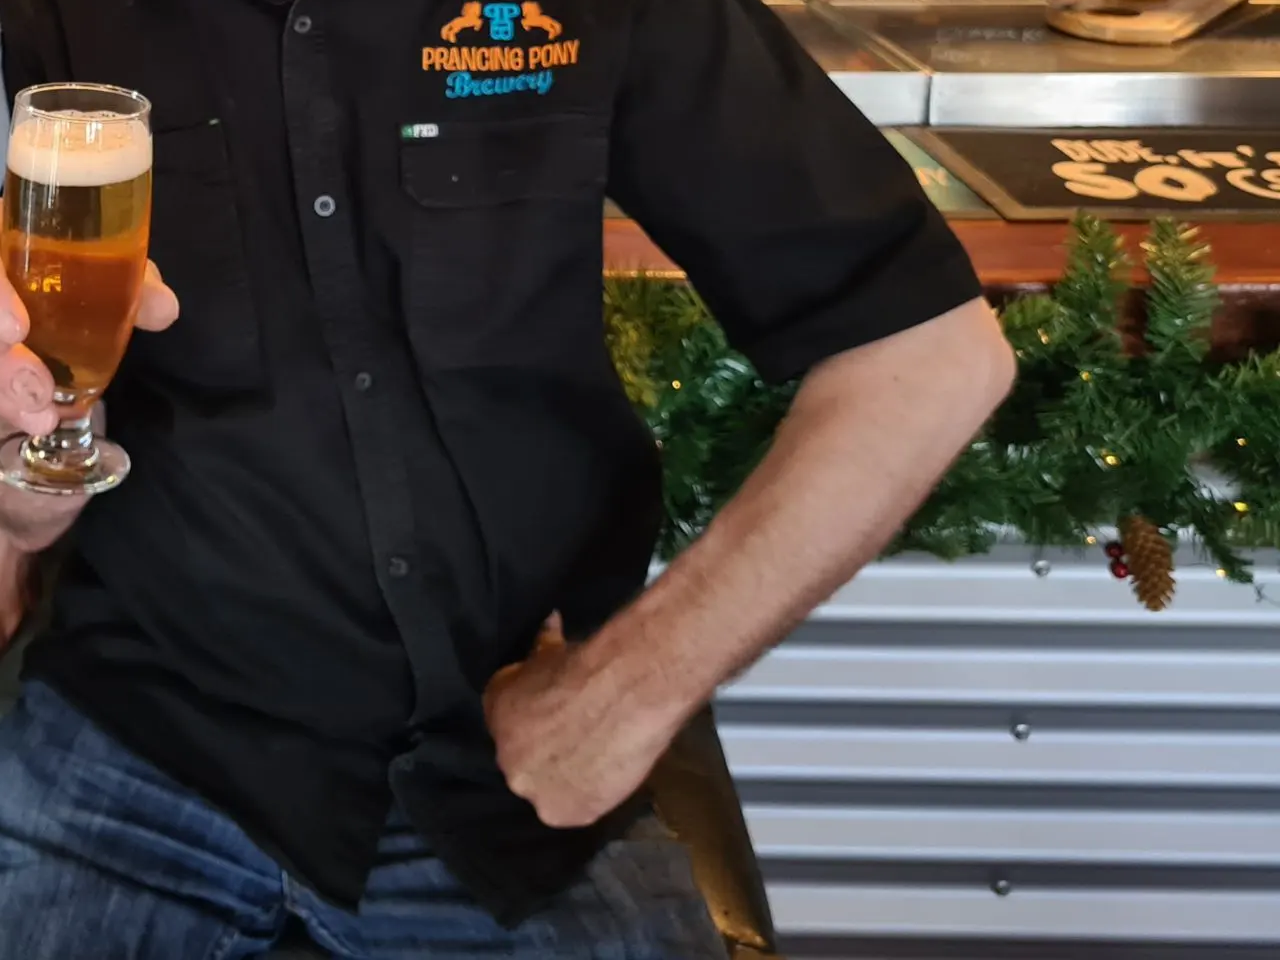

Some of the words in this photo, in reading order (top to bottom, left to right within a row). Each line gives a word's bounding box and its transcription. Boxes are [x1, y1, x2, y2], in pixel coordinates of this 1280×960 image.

[422, 46, 524, 72] PRANCING
[529, 40, 580, 69] PONY
[445, 70, 552, 98] Brewery
[1052, 160, 1218, 202] SO
